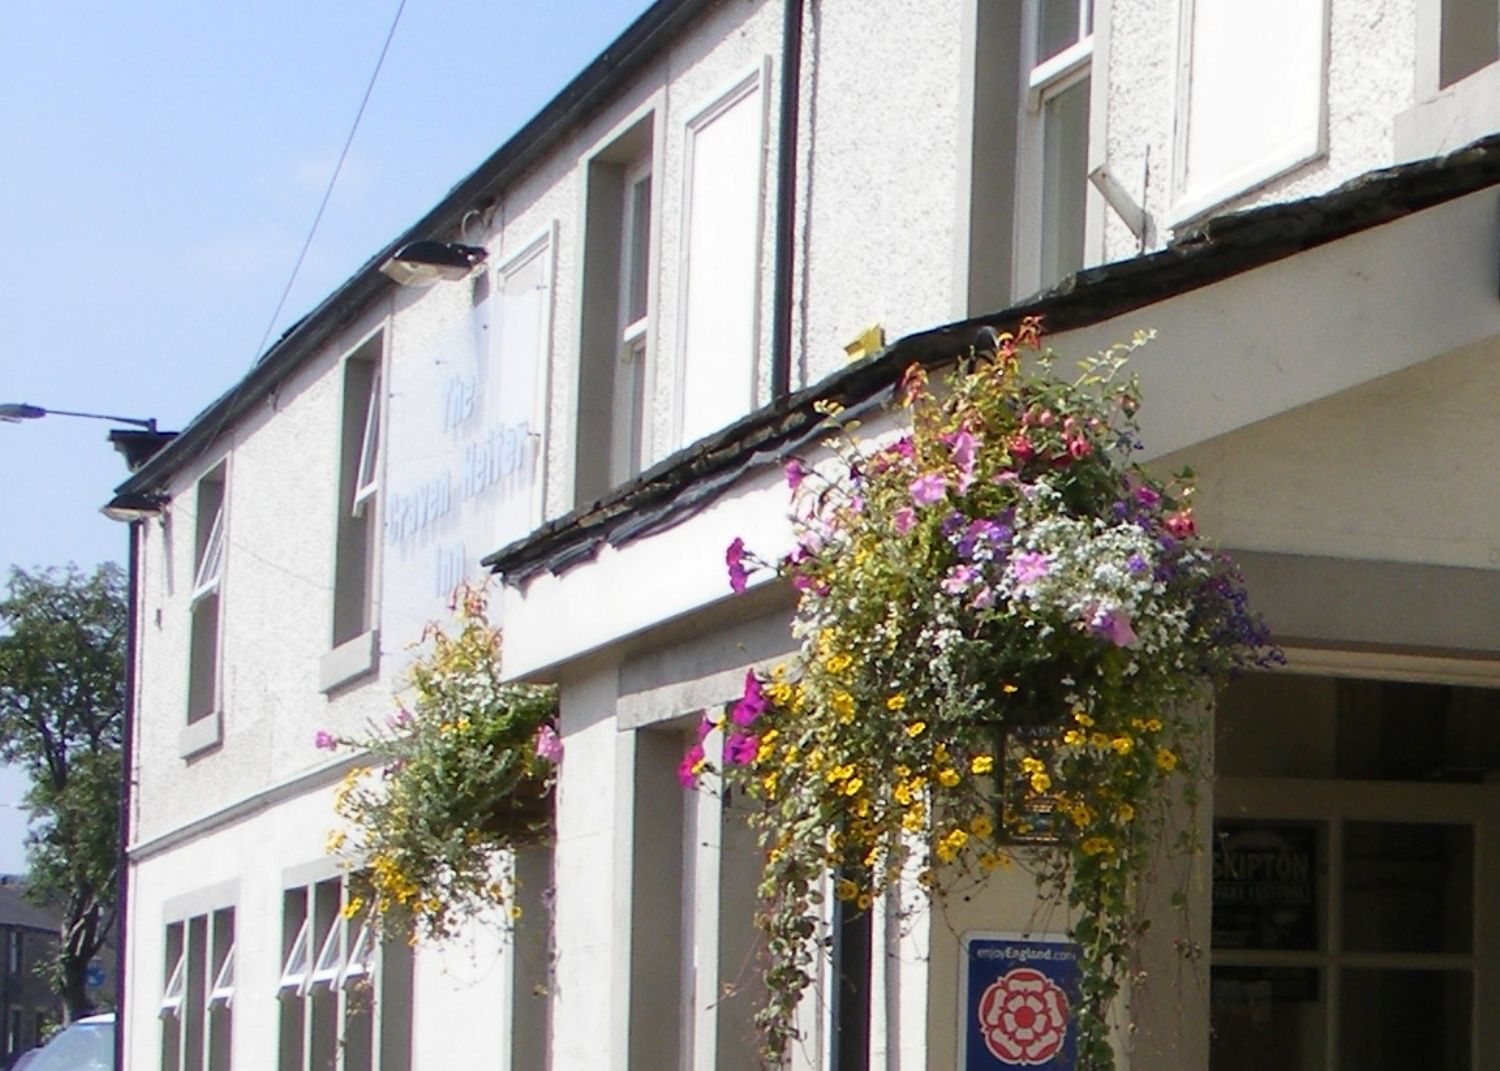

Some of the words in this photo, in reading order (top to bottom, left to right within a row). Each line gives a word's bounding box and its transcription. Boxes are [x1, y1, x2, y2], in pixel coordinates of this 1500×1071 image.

[388, 470, 452, 546] Craven
[462, 419, 529, 502] Heifer
[1212, 852, 1309, 880] SKIPTON
